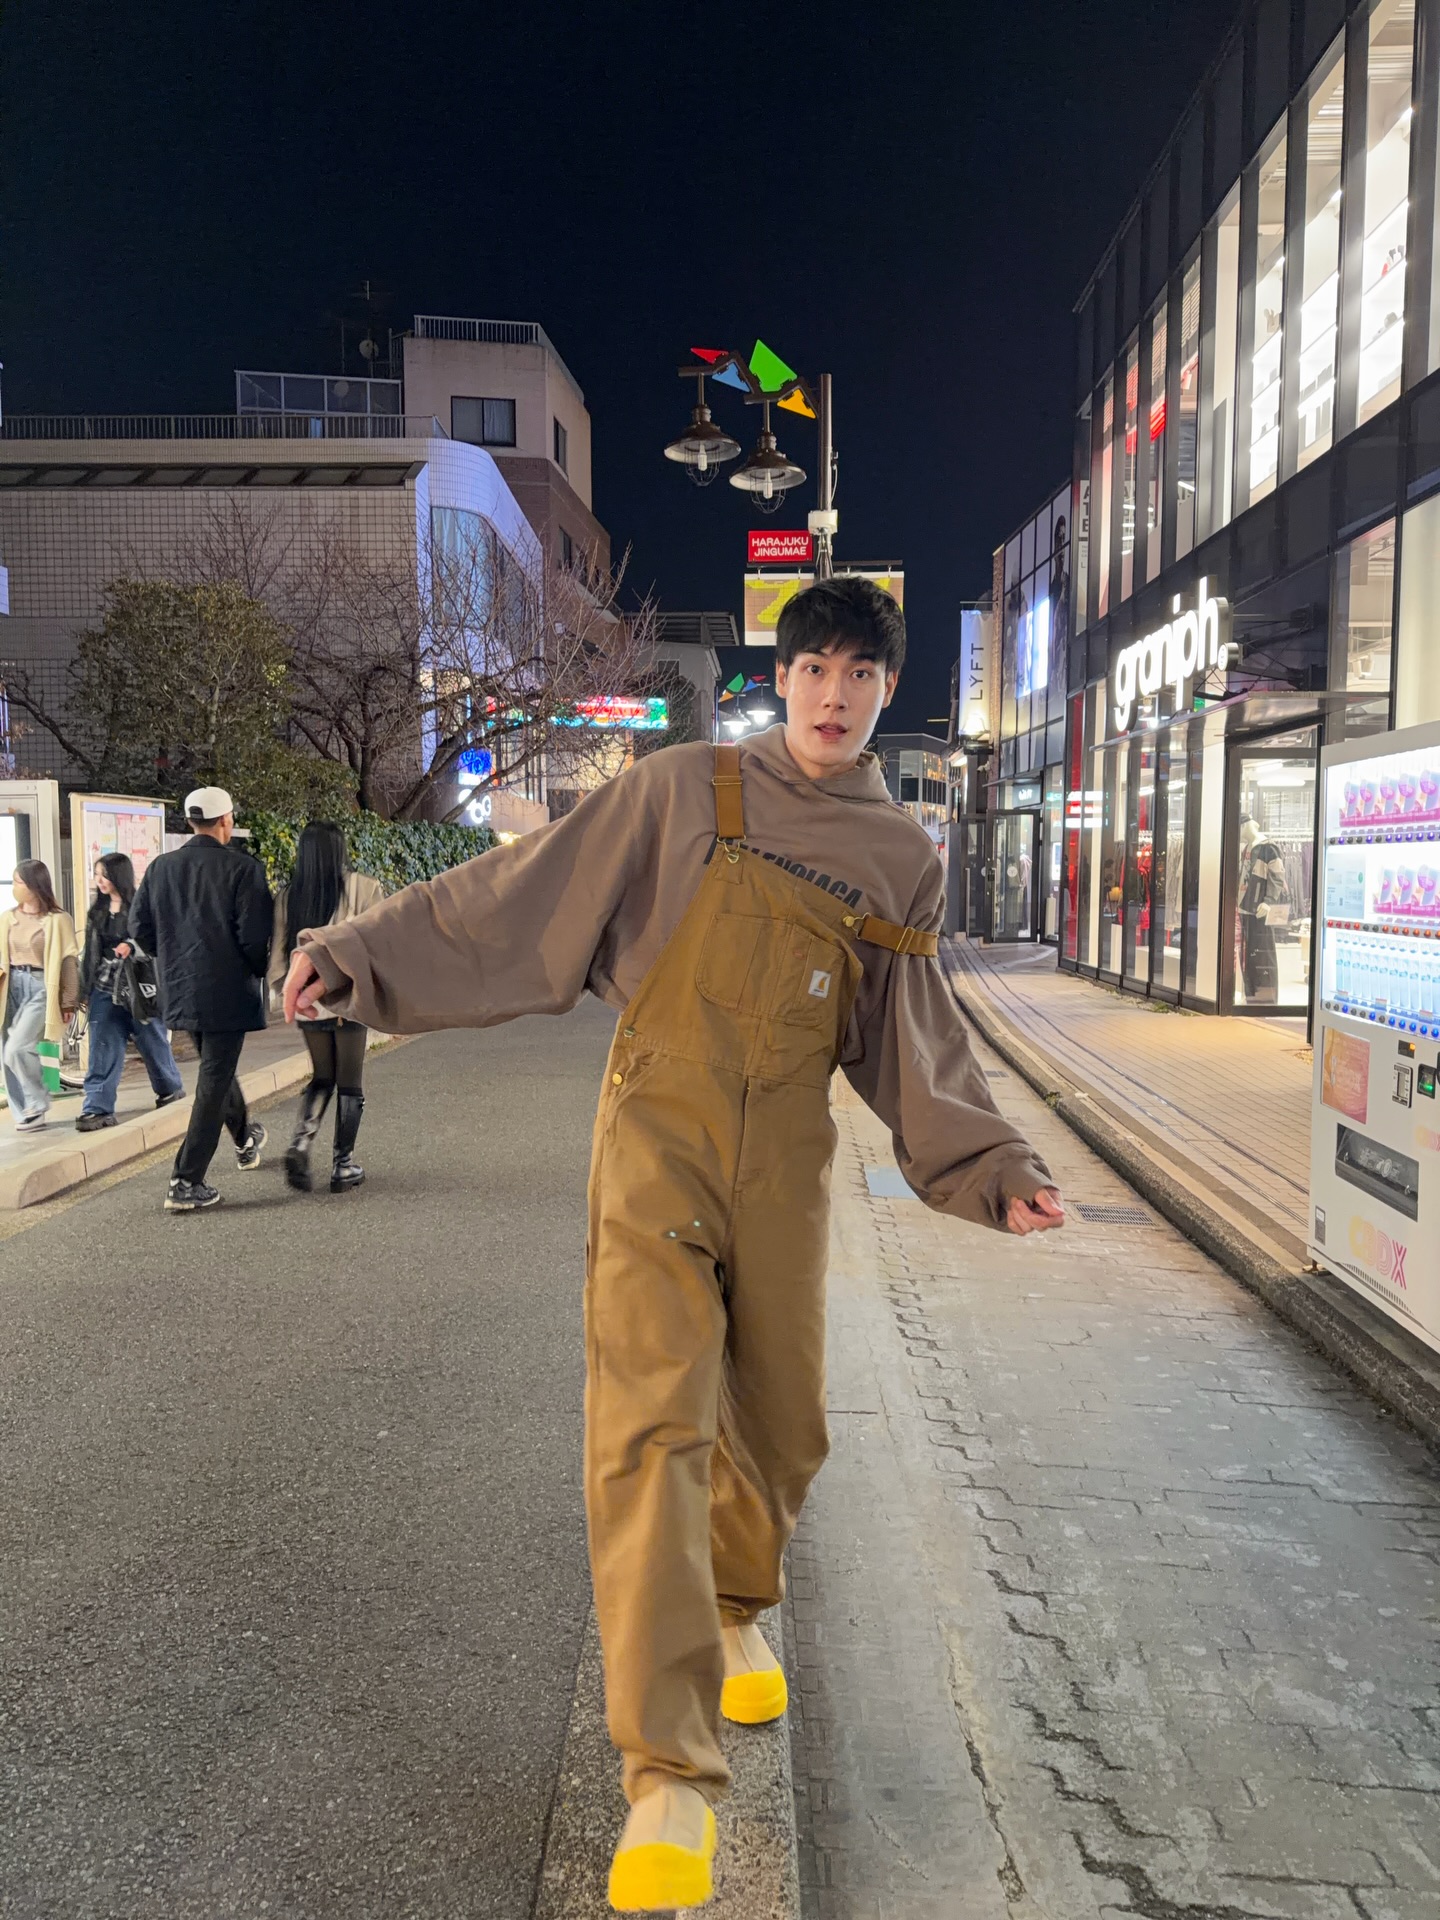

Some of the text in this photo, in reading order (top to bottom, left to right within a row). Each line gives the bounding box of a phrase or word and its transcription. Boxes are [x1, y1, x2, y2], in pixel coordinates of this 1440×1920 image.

[751, 536, 809, 547] HARAJUKU
[754, 547, 807, 557] JINGUMAE
[1114, 575, 1220, 732] graniph
